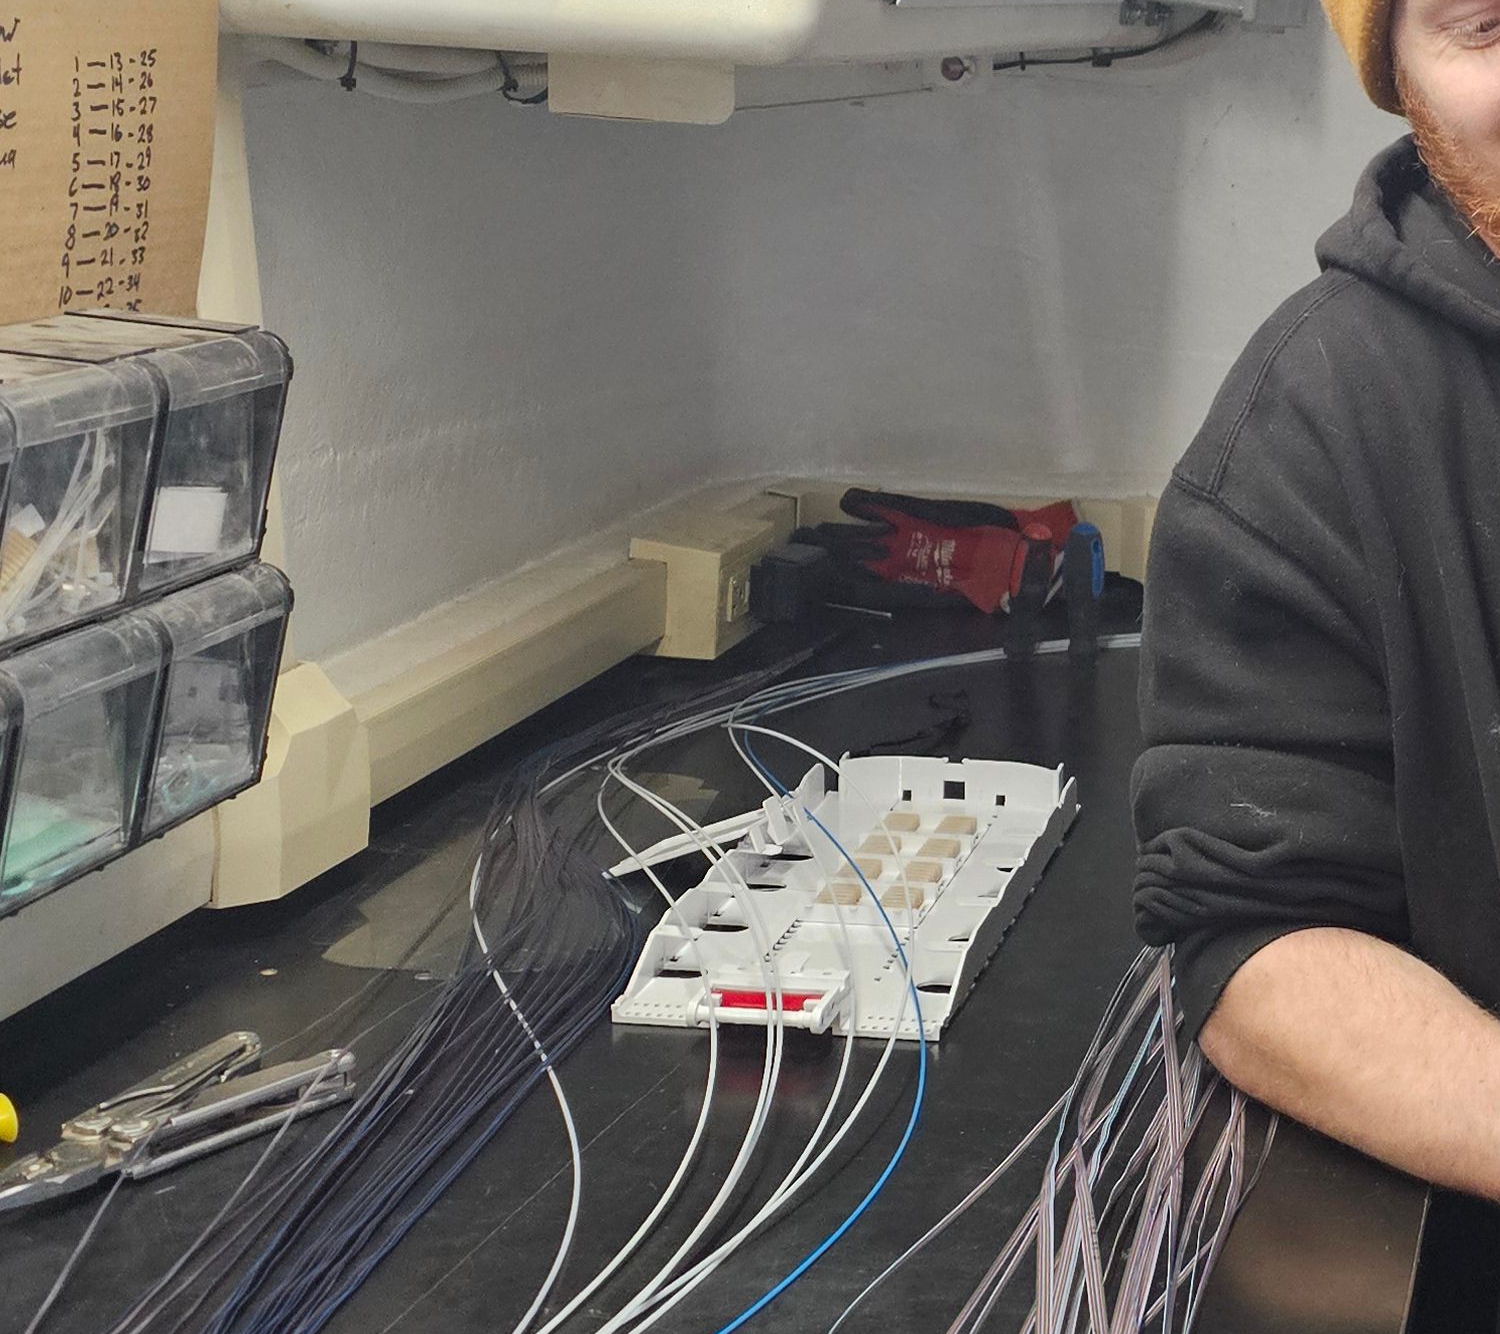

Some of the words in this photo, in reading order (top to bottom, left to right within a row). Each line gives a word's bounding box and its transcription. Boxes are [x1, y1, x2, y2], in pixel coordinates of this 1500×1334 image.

[110, 52, 123, 72] 13
[140, 48, 157, 67] 25
[72, 78, 81, 97] 2
[111, 73, 123, 94] 14
[139, 71, 154, 90] 26
[71, 101, 81, 121] 3
[112, 98, 125, 117] 15
[139, 96, 157, 115] 27
[72, 123, 81, 147] 4
[111, 124, 123, 142] 16
[137, 123, 154, 143] 28
[72, 152, 81, 173] 5
[110, 151, 121, 169] 17
[137, 145, 152, 170] 29
[68, 176, 78, 198] 6
[109, 171, 121, 195] 18
[136, 174, 151, 192] 30
[69, 202, 79, 220] 7
[136, 199, 149, 219] 31
[64, 224, 76, 251] 8
[134, 221, 149, 243] 32
[61, 252, 70, 278] 9
[101, 247, 113, 266] 21
[131, 246, 146, 265] 33
[59, 285, 73, 309] 10
[97, 277, 114, 300] 22
[126, 273, 141, 292] 34
